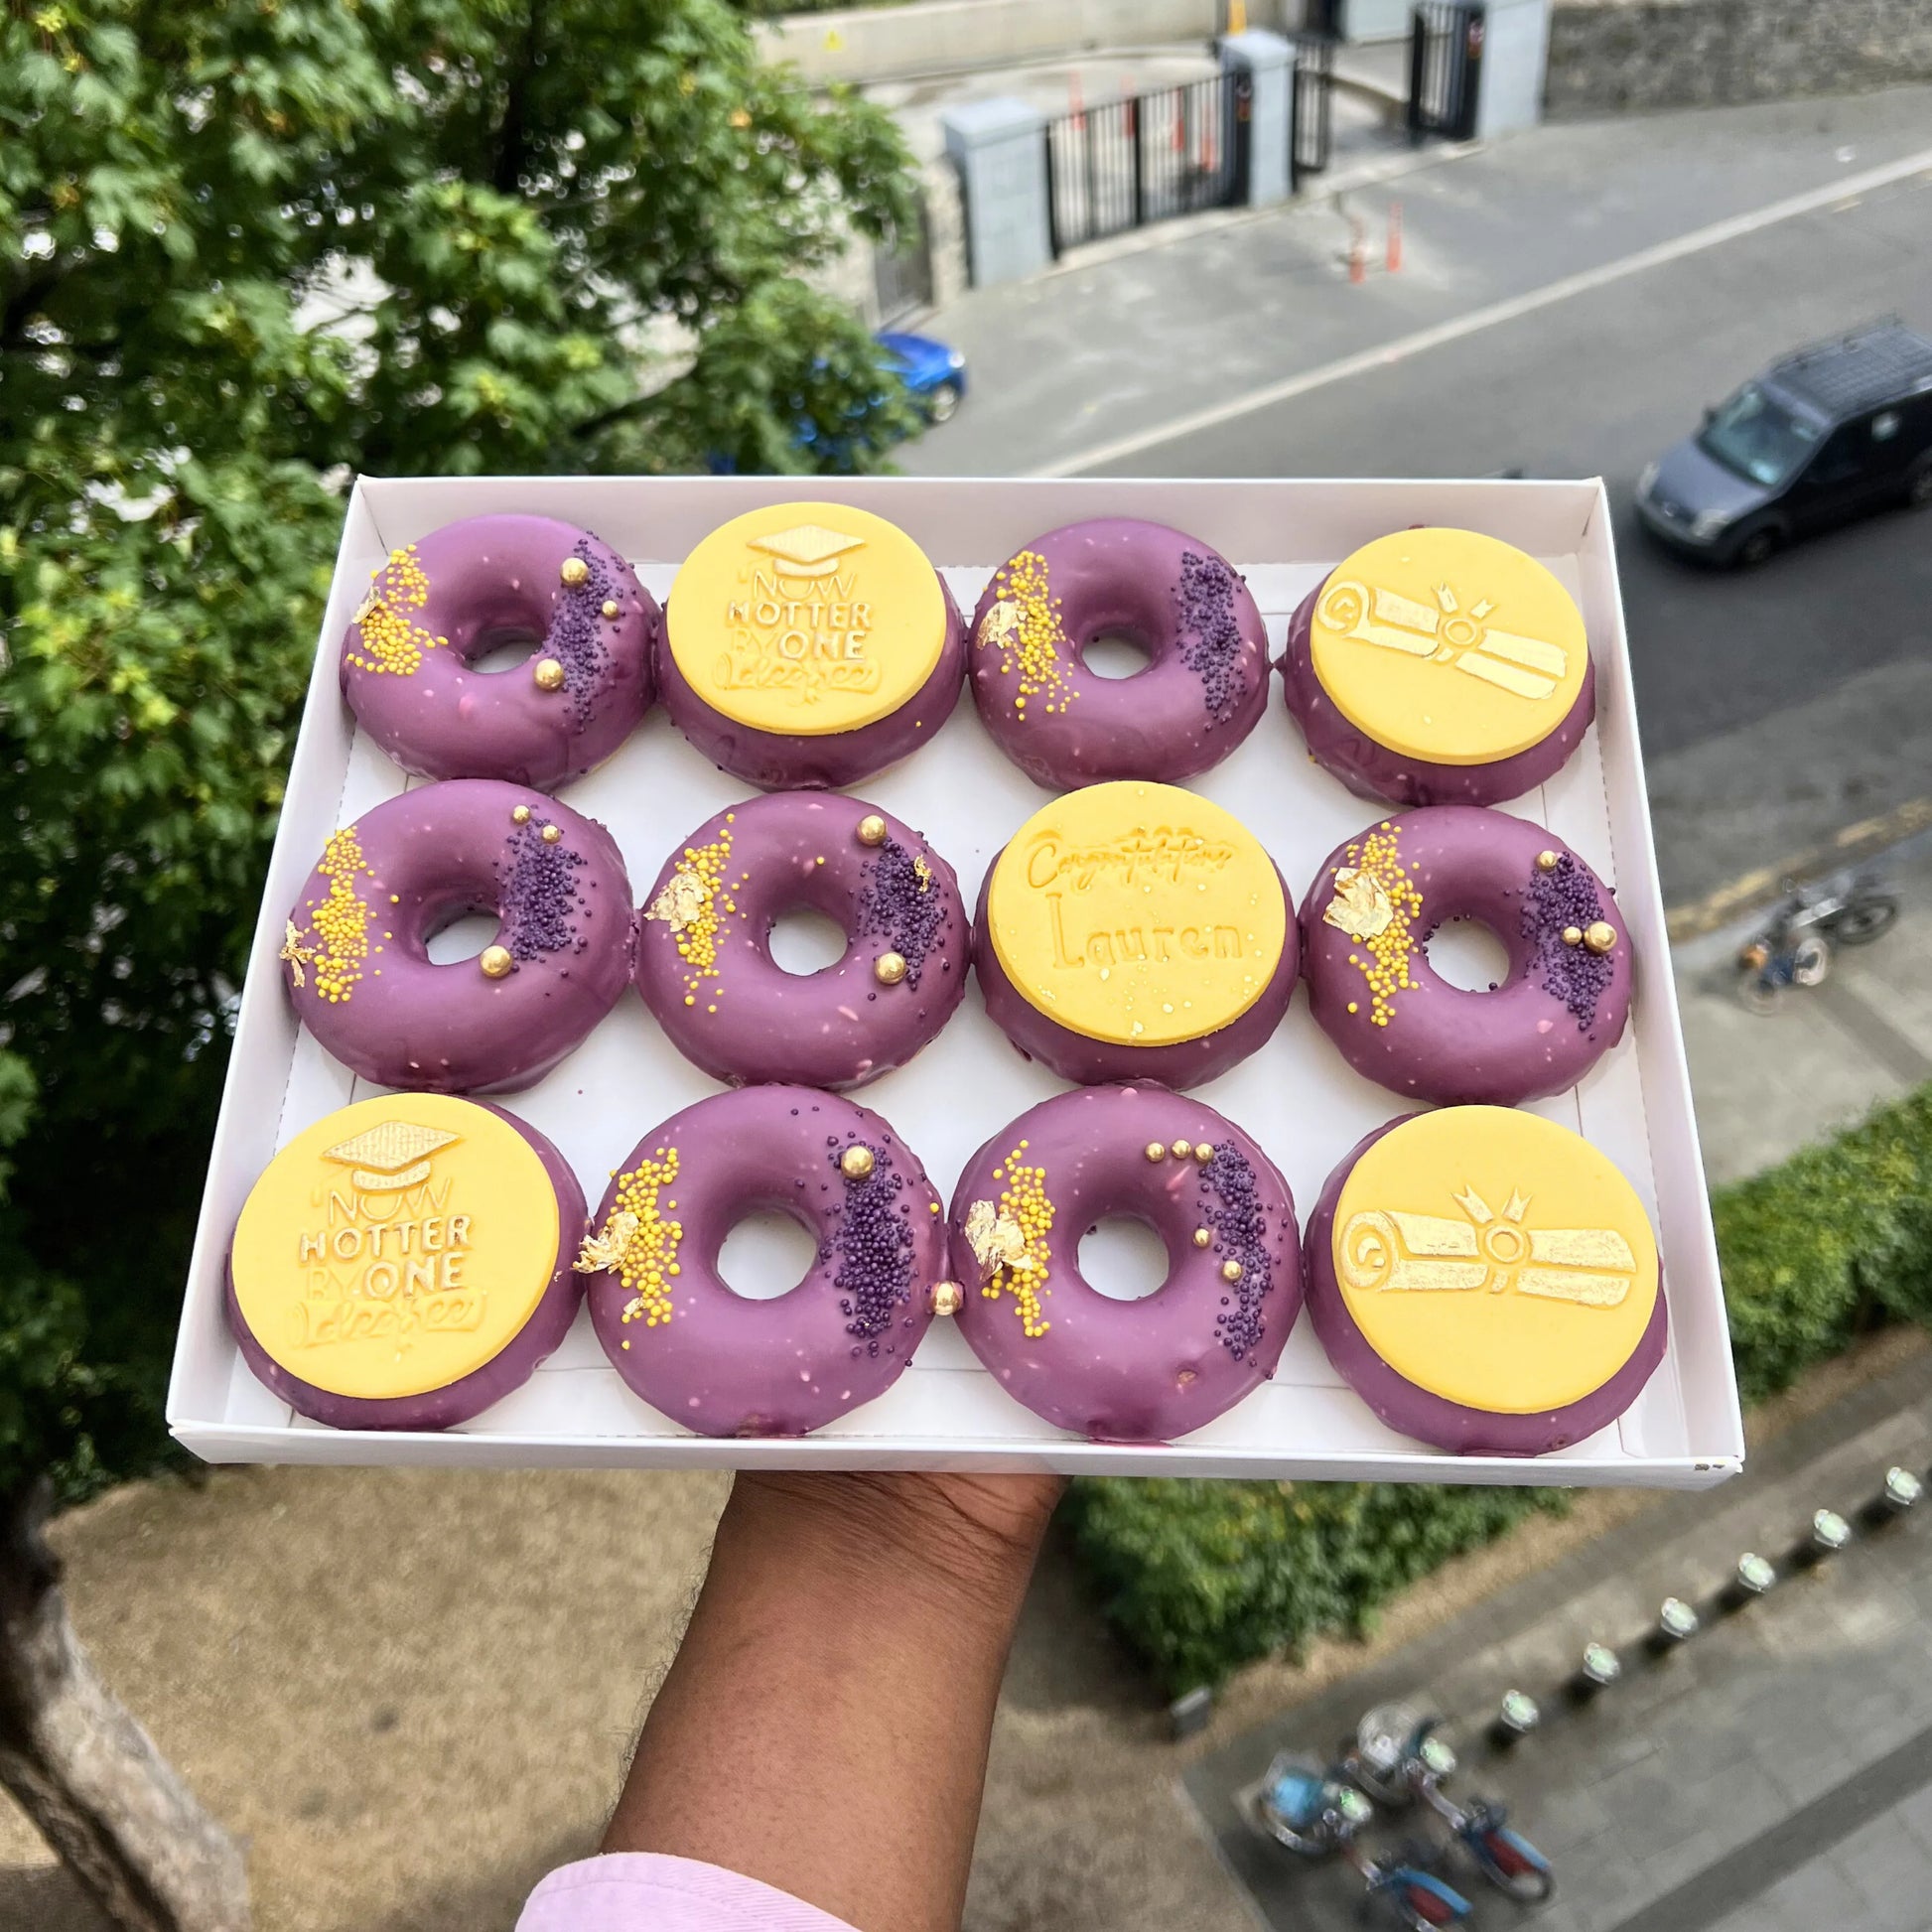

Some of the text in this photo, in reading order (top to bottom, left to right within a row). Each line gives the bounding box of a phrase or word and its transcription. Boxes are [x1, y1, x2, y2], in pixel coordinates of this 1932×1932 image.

[754, 571, 857, 600] NOW
[732, 628, 868, 660] BY ONE
[1045, 893, 1244, 970] Lauren
[329, 1176, 452, 1225] NOW
[300, 1214, 474, 1263] HOTTER
[307, 1251, 465, 1302] BY ONE
